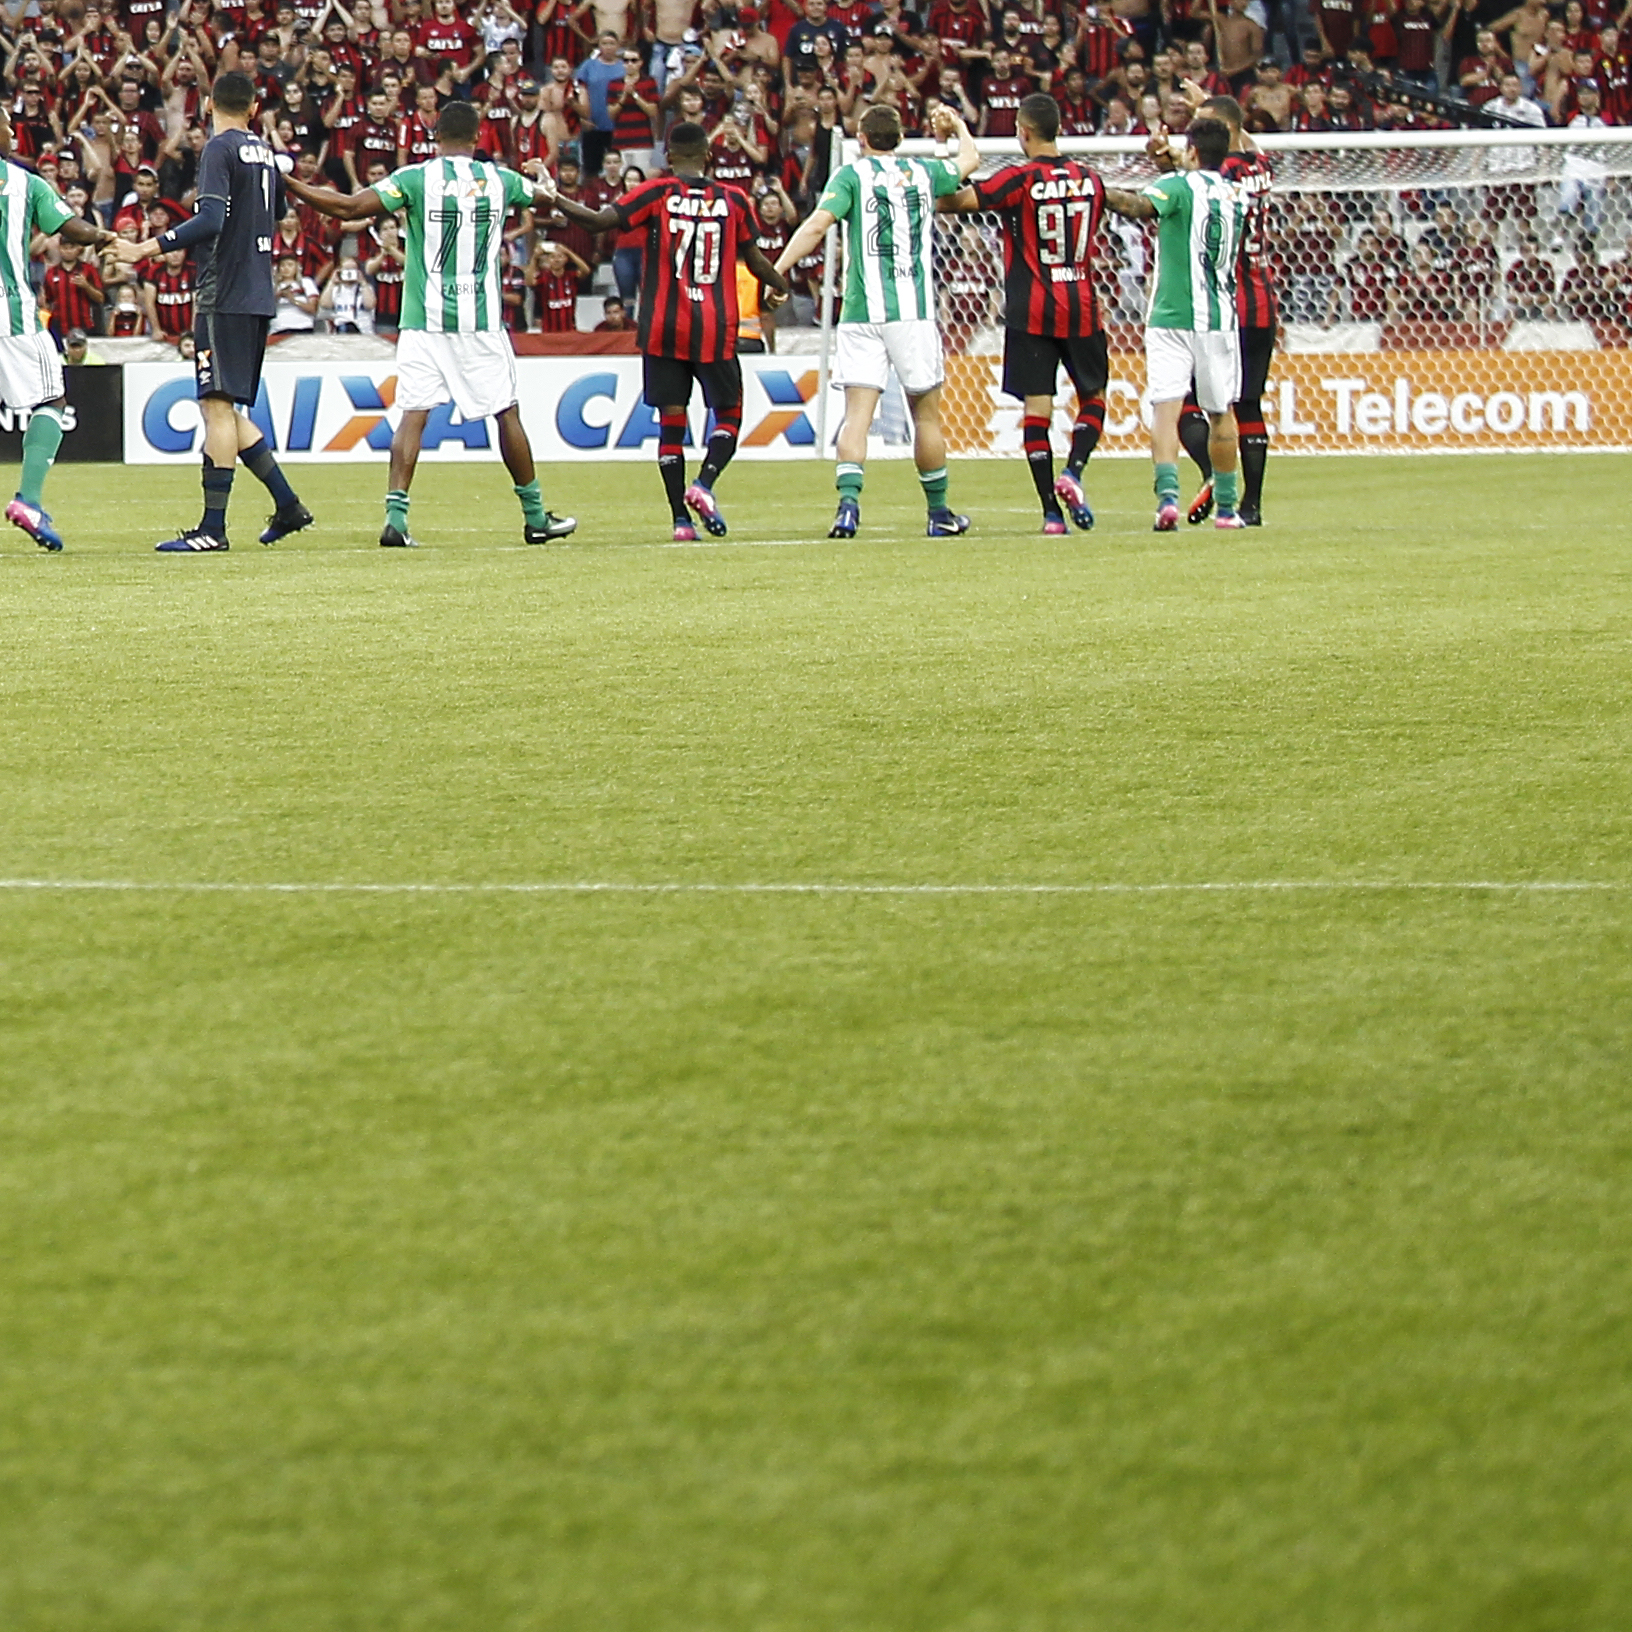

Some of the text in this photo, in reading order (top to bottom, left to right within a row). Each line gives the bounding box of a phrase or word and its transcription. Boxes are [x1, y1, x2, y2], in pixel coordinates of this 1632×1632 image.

[130, 1, 162, 13] CAIXA
[715, 167, 751, 178] CAIXA
[431, 179, 498, 198] CAIXA
[1030, 177, 1095, 200] CAIXA
[667, 194, 729, 218] CAIXA
[429, 209, 501, 275] 77
[1038, 202, 1092, 266] 97
[668, 218, 724, 285] 70
[1318, 379, 1589, 436] Telecom
